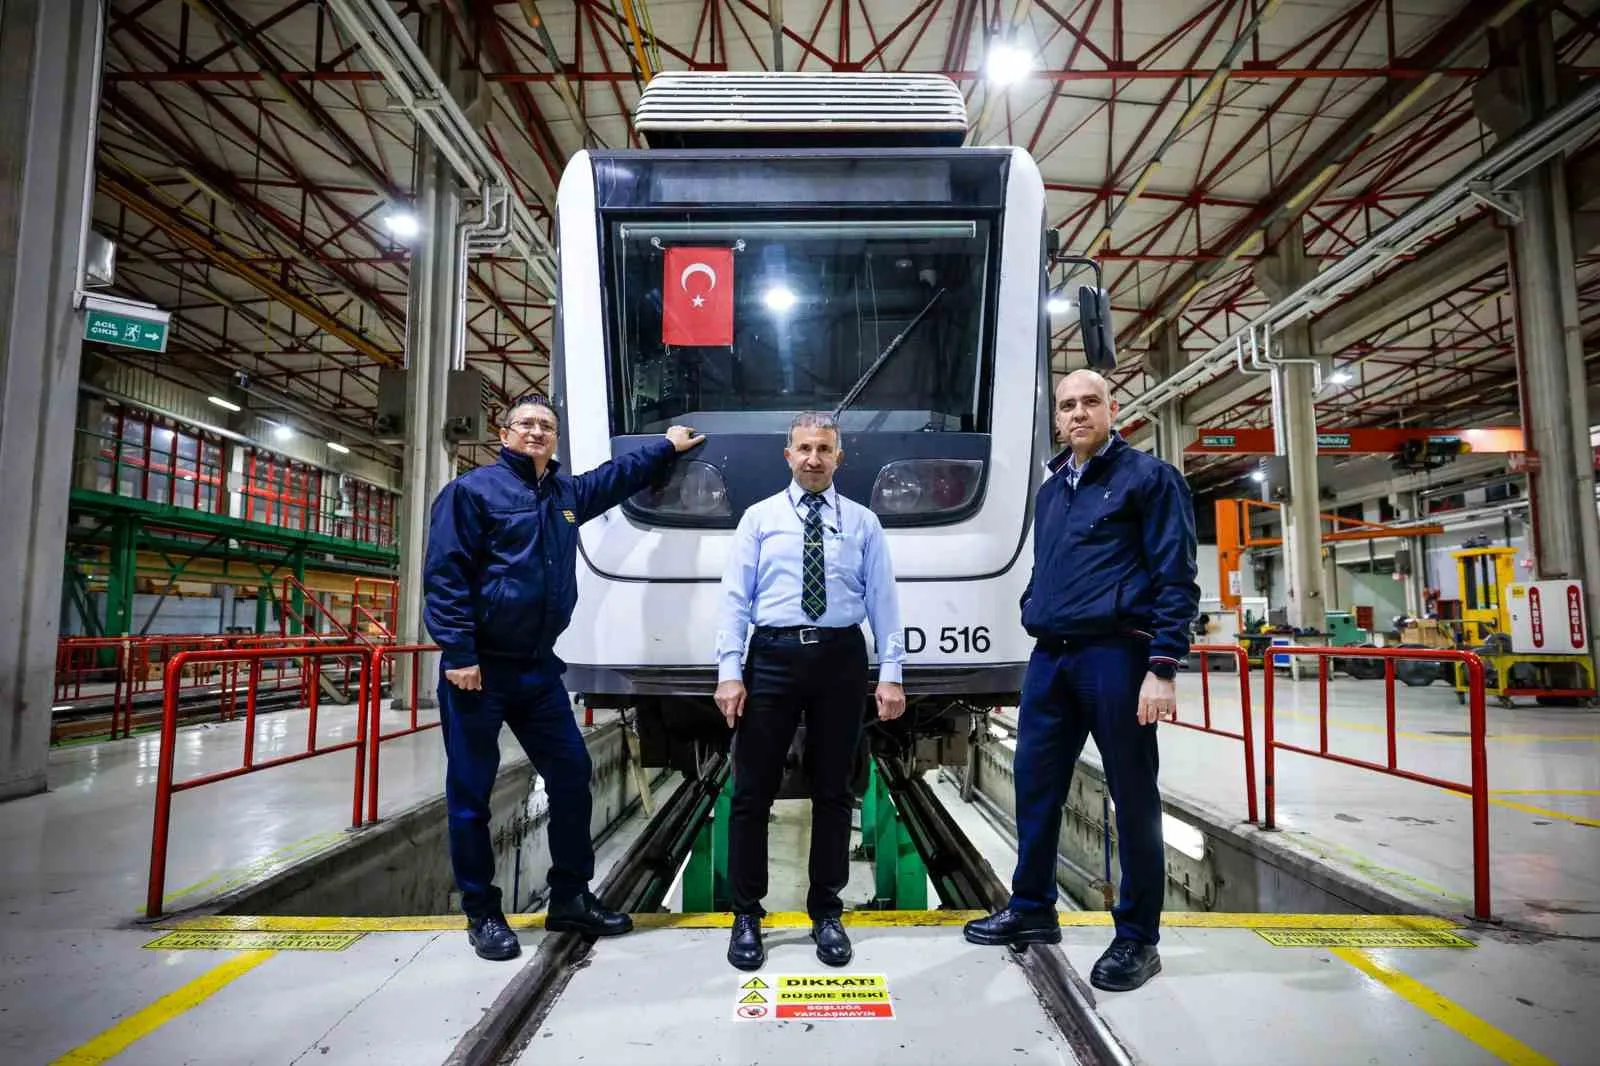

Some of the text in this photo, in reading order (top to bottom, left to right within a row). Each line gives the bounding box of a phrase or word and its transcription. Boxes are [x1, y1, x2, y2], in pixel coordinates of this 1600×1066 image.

[1530, 594, 1542, 641] YANGIN
[1569, 592, 1582, 641] YANGIN
[939, 626, 991, 654] 516
[786, 978, 876, 986] DİKKAT!
[841, 991, 884, 999] RİSKİ
